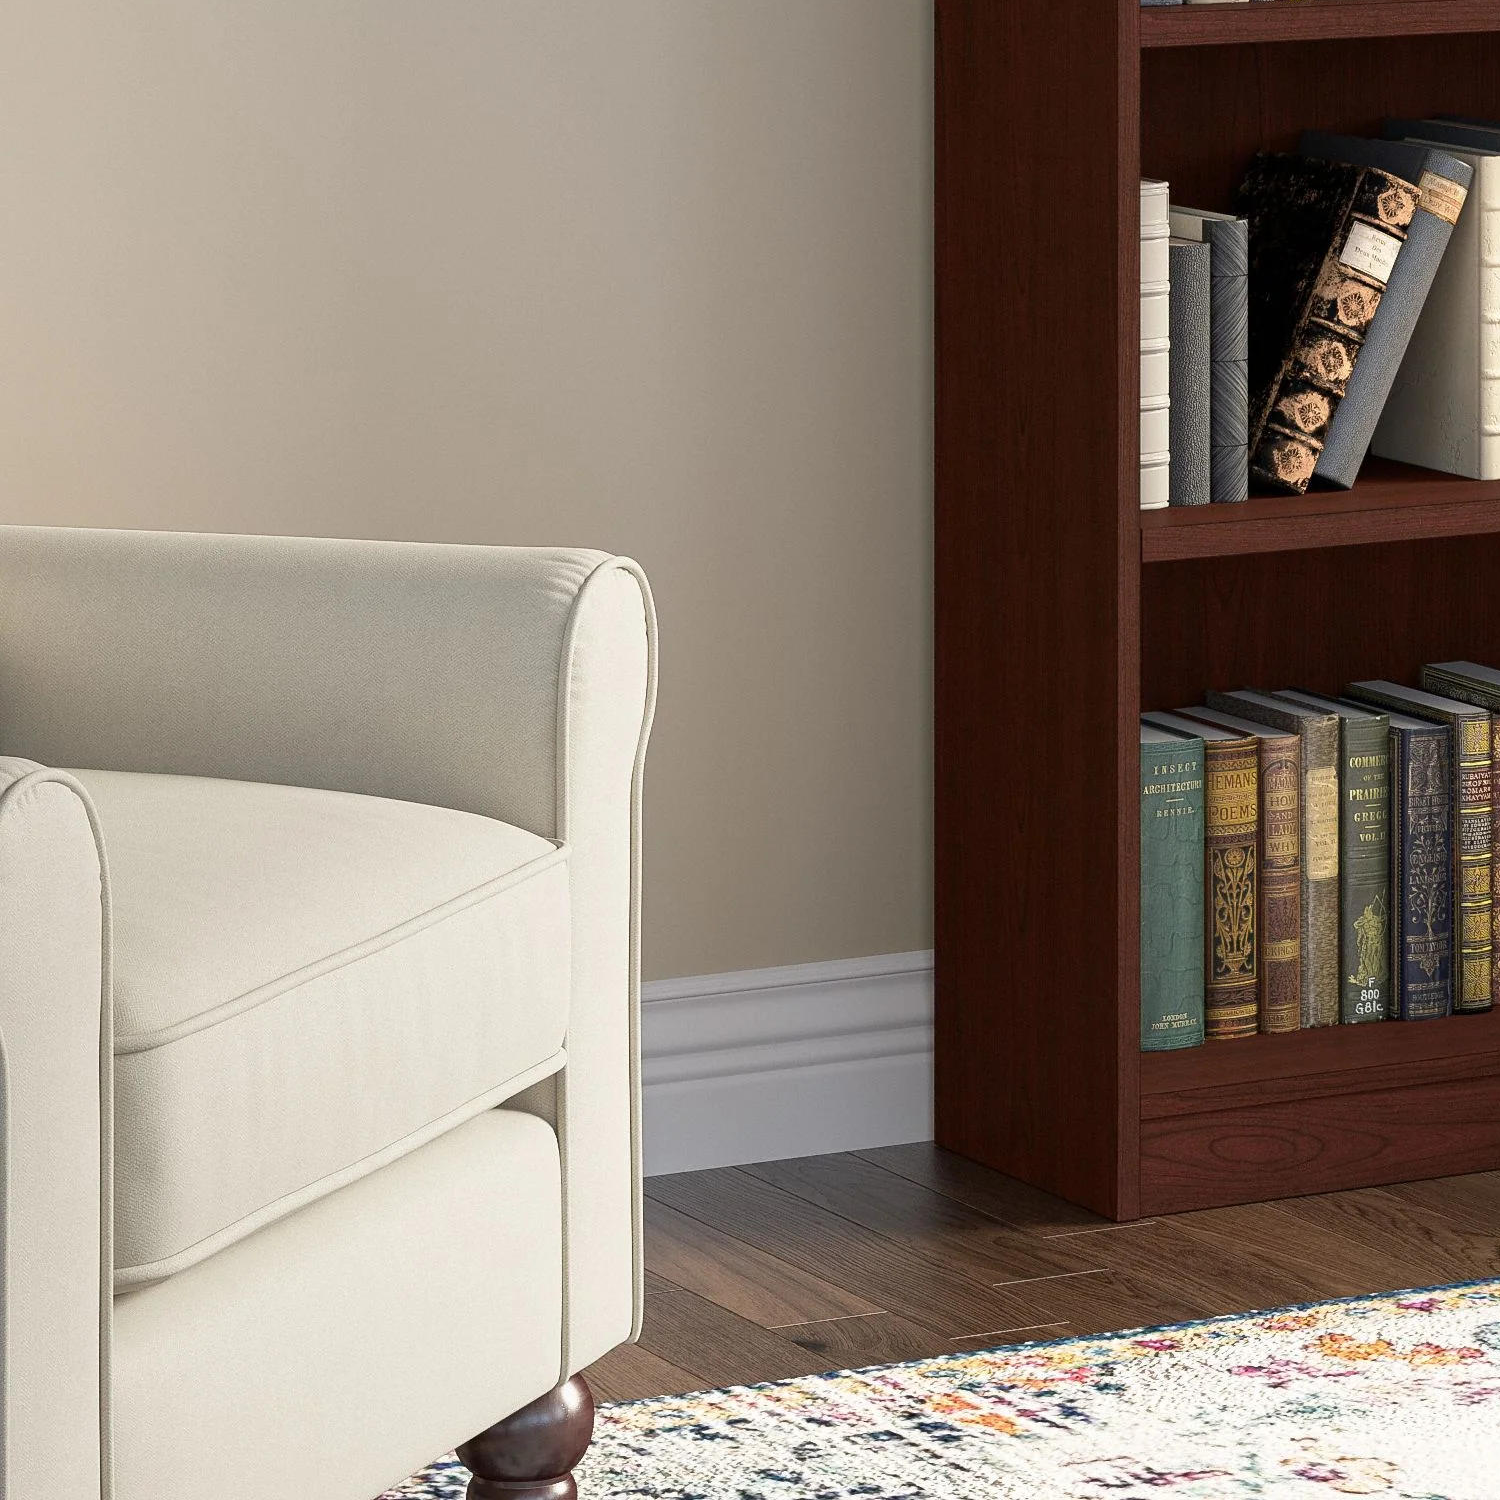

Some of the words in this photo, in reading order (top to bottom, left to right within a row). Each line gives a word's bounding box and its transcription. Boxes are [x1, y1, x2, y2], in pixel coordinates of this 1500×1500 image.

[1154, 762, 1198, 775] INSECT
[1207, 771, 1257, 790] HEMANS
[1270, 795, 1296, 807] HOW
[1207, 804, 1257, 821] POEMS
[1271, 823, 1295, 836] LADY
[1268, 841, 1296, 852] WHY
[1368, 977, 1376, 988] F
[1360, 988, 1380, 1001] 800
[1162, 1012, 1188, 1021] LONDON
[1151, 1021, 1169, 1030] JOHN
